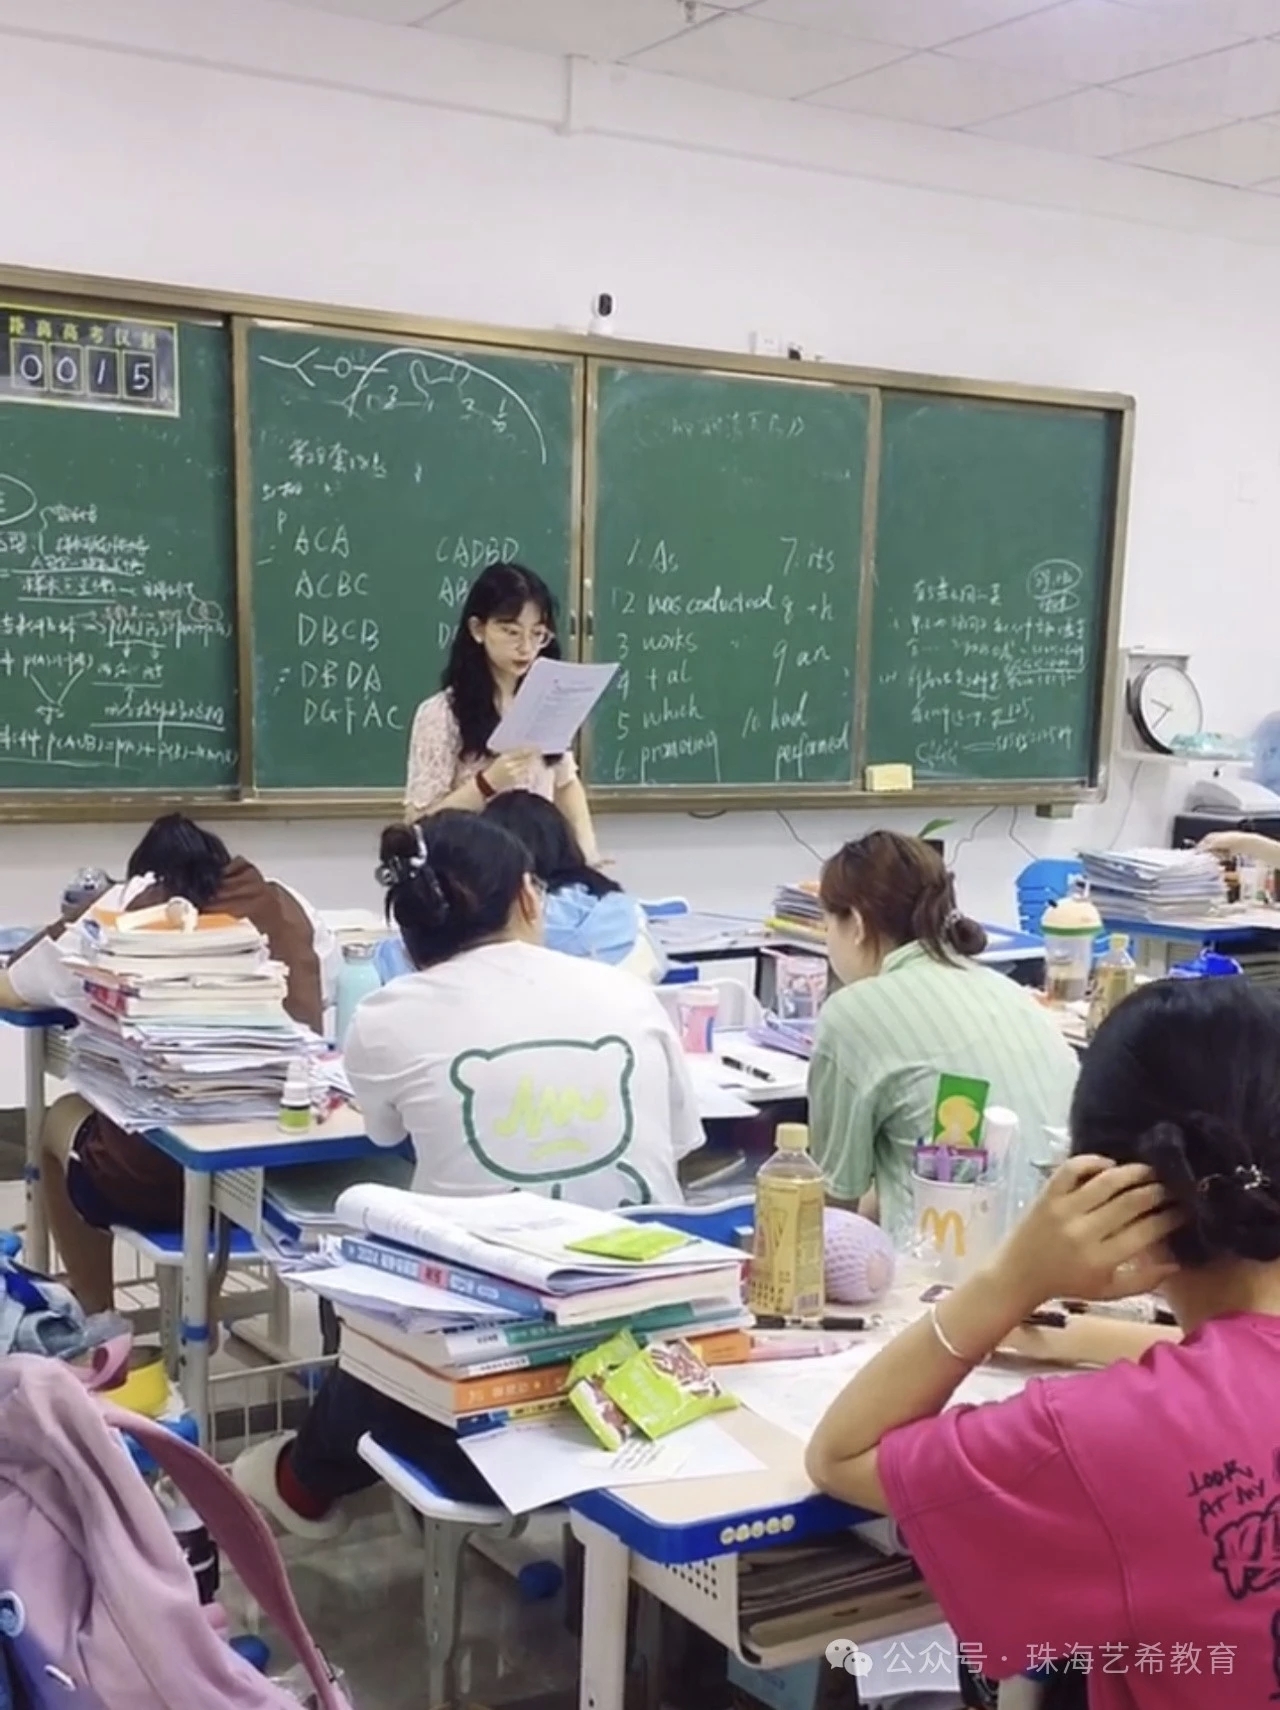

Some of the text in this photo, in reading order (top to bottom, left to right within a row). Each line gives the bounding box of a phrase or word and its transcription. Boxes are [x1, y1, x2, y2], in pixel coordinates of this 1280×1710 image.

[436, 535, 518, 567] CADBD
[296, 570, 369, 600] ACBC
[298, 612, 380, 652] DBCB
[643, 629, 698, 654] works
[301, 659, 381, 692] DBDA
[617, 693, 704, 741] 5 which
[770, 690, 808, 731] had
